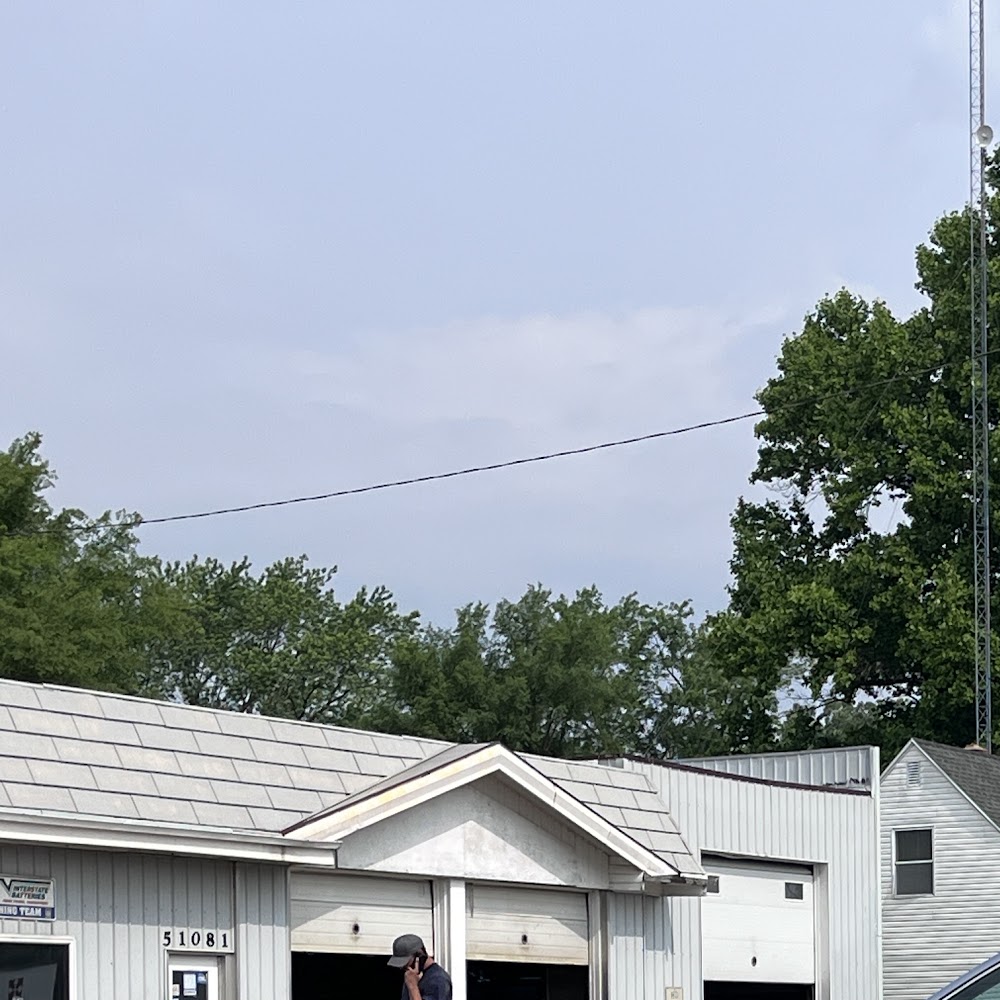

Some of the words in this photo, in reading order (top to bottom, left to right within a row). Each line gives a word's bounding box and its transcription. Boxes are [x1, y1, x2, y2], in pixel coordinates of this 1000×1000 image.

[13, 886, 48, 894] INTERSTATE
[11, 892, 45, 900] BATTERIES
[163, 931, 228, 948] 51081
